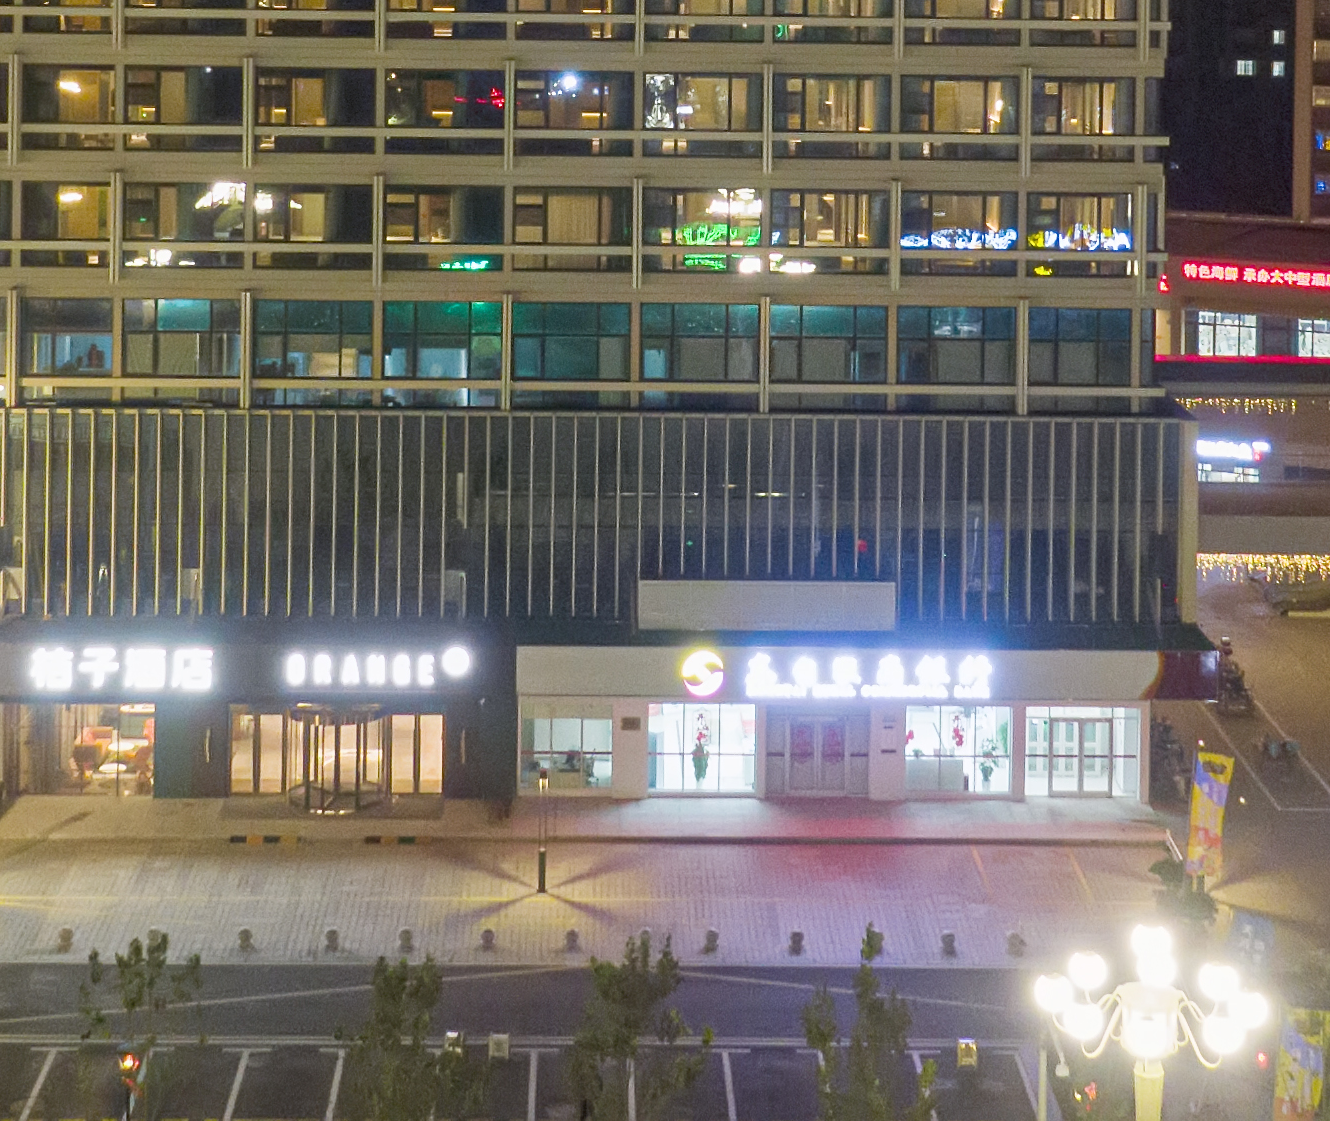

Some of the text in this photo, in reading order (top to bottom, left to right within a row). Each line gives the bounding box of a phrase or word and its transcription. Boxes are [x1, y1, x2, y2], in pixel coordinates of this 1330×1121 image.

[30, 646, 435, 690] 桔子酒店 ORANGE
